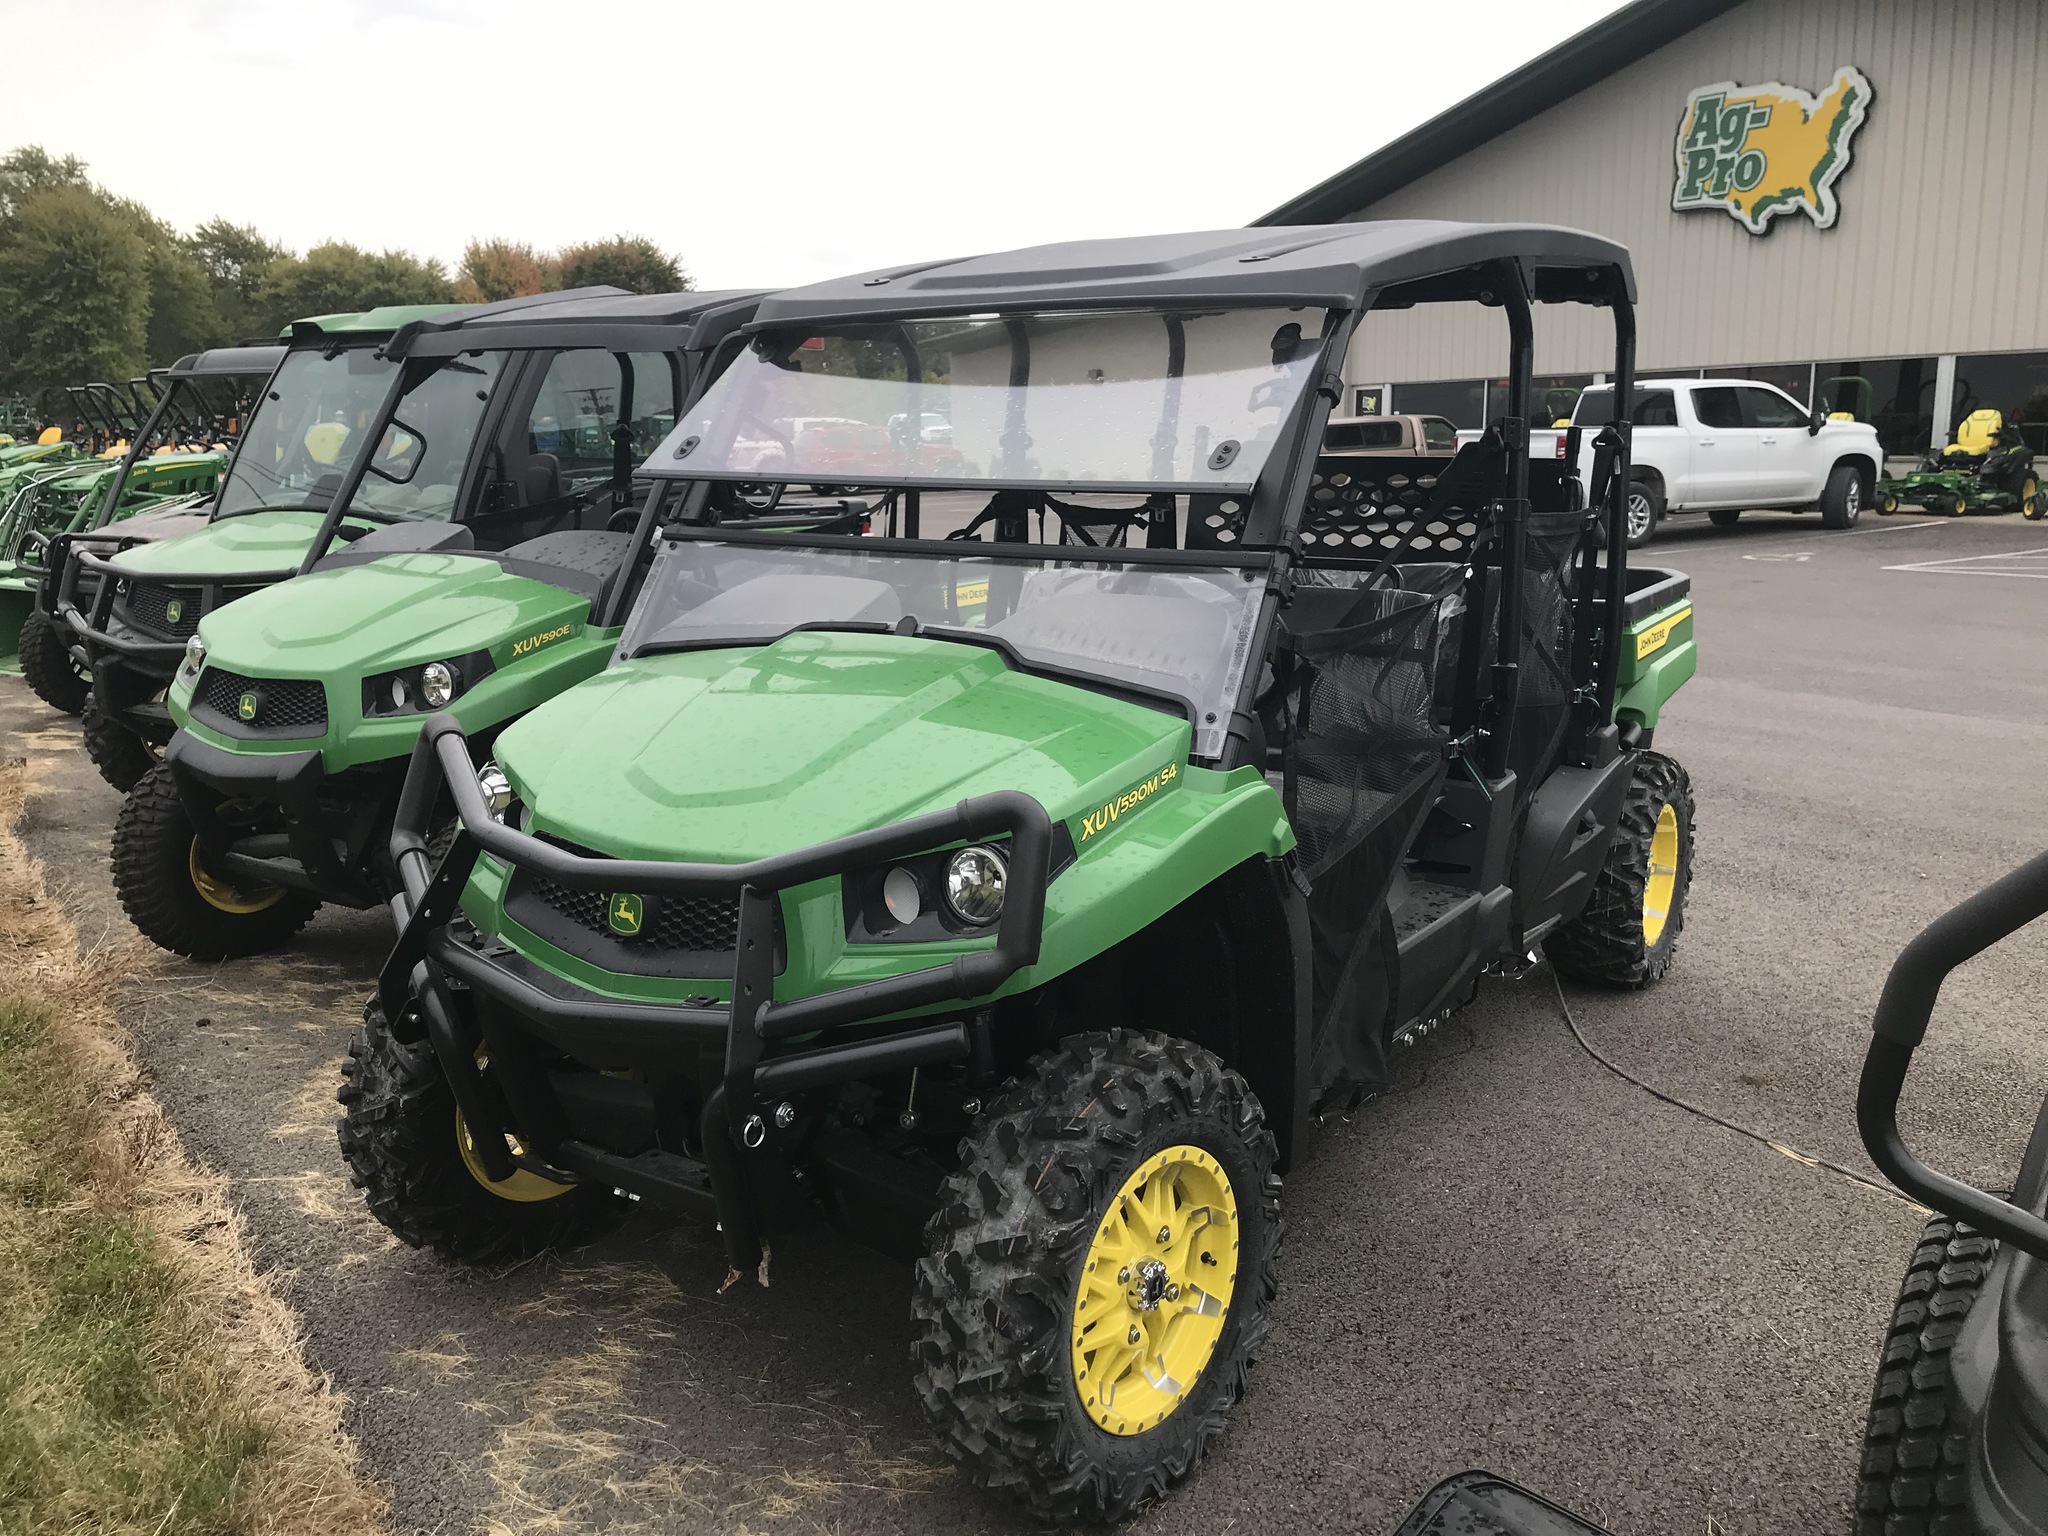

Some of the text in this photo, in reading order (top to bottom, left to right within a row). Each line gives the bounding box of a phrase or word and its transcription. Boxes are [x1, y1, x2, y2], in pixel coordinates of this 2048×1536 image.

[1684, 91, 1773, 155] Ag-
[1678, 148, 1766, 202] Pro
[969, 588, 988, 599] DEER
[512, 624, 570, 657] XUV590E
[1651, 629, 1665, 644] DEERE
[1080, 762, 1177, 842] XUV590M S4
